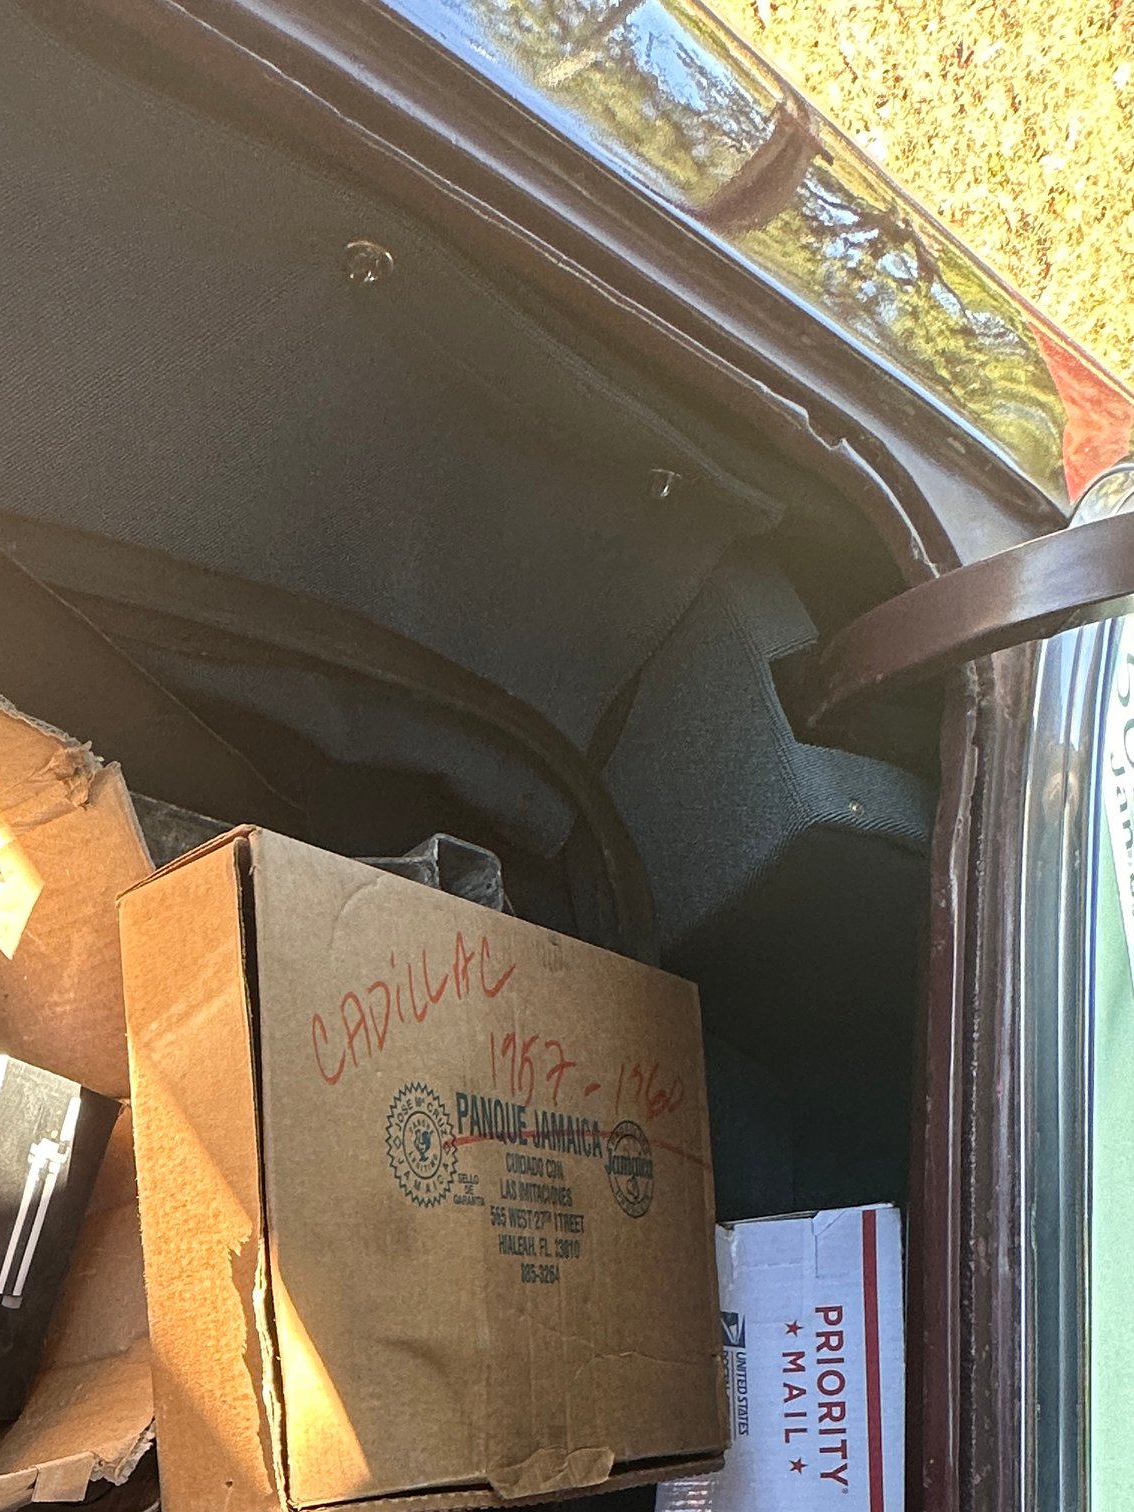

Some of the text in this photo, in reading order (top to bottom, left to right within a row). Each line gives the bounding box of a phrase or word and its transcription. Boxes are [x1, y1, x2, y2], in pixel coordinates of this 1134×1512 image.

[456, 1091, 528, 1146] PANQUE
[532, 1109, 604, 1159] JAMAICA
[508, 1207, 535, 1230] WEST
[735, 1351, 750, 1437] UNITED STATES
[781, 1350, 808, 1444] MAIL
[814, 1305, 849, 1487] PRIORITY
